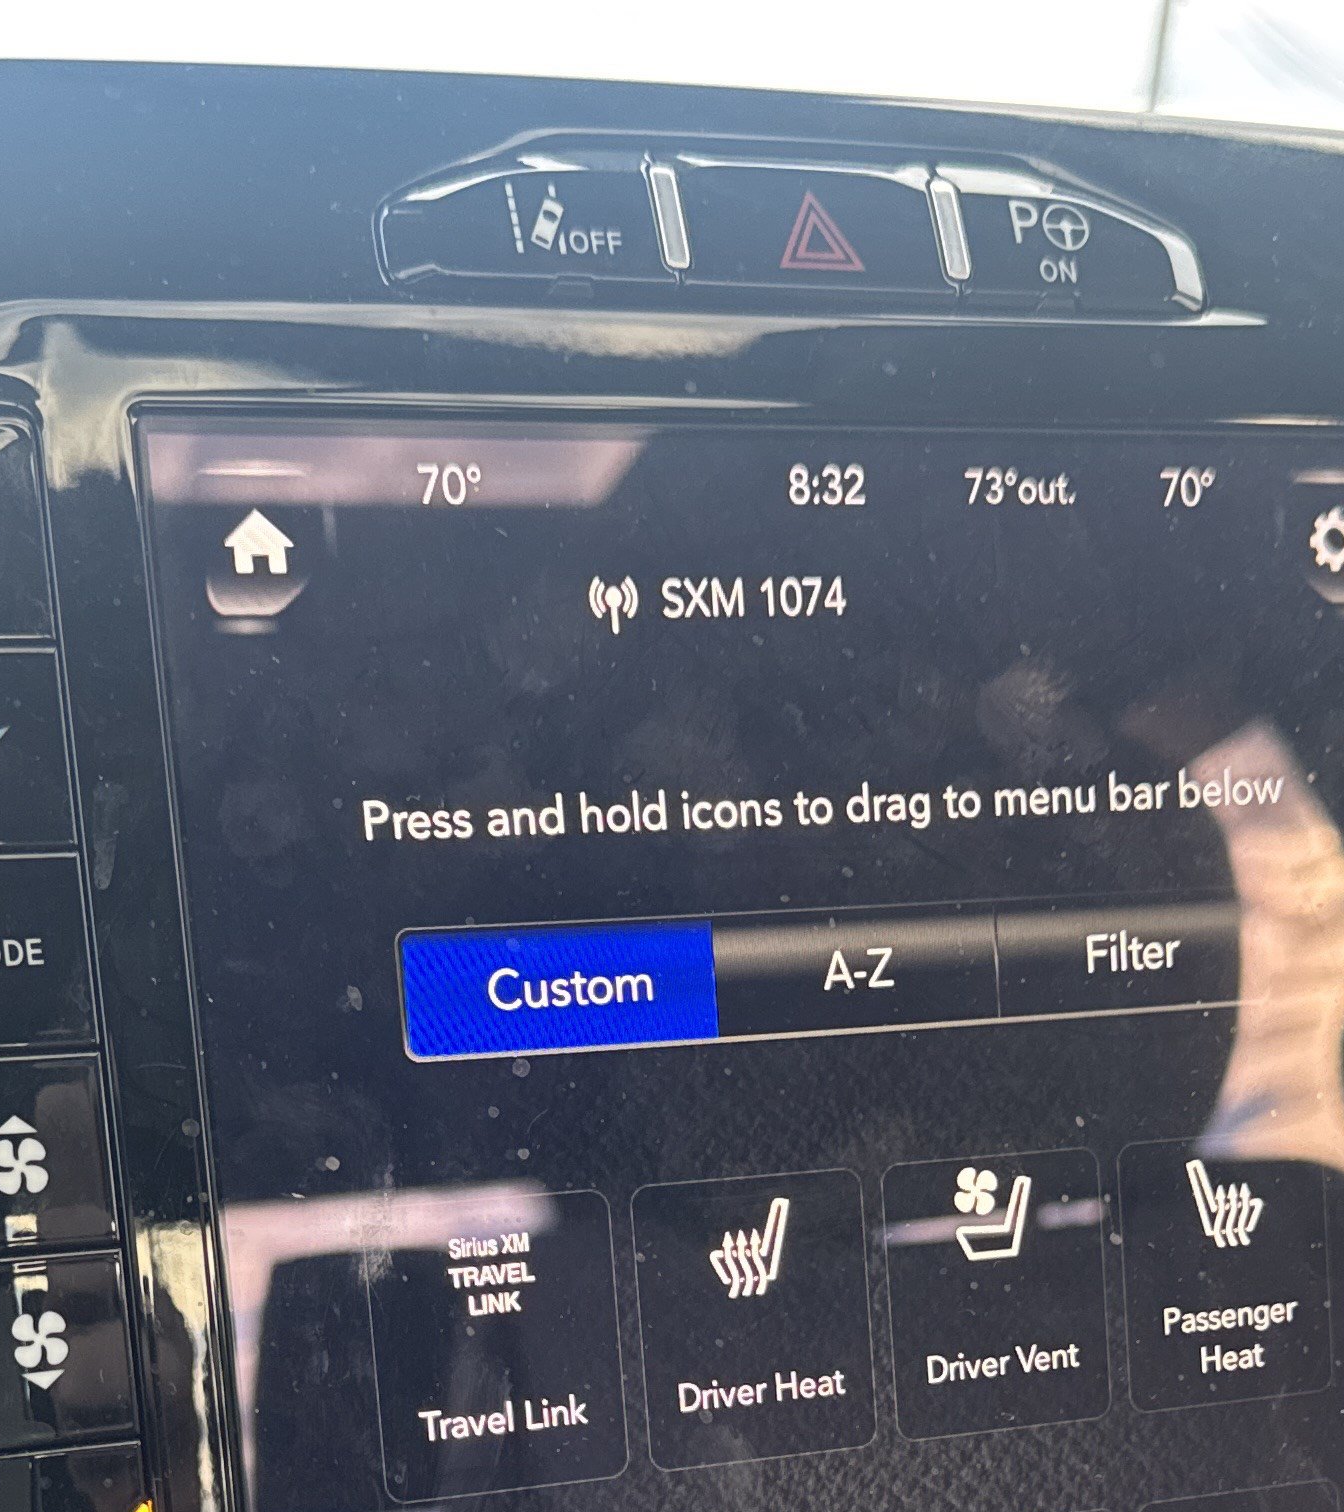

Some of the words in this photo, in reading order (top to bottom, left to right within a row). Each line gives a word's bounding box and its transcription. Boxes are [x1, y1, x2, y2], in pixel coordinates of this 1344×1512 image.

[569, 229, 622, 255] OFF
[1040, 258, 1079, 285] ON
[416, 462, 482, 506] 70°
[788, 463, 866, 506] 8:32
[1159, 466, 1216, 507] 70°
[661, 575, 745, 619] SXM
[759, 575, 846, 617] 1074
[362, 797, 472, 840] Press
[486, 792, 564, 837] and
[580, 788, 667, 833] hold
[683, 784, 783, 830] icons
[793, 790, 834, 826] to
[846, 781, 931, 829] drag
[943, 784, 982, 821] to
[994, 780, 1096, 818] menu
[1109, 771, 1167, 812] bar
[1178, 768, 1284, 809] below
[823, 946, 896, 991] A-Z
[1084, 931, 1180, 975] Filter
[486, 966, 655, 1012] Custom
[448, 1235, 498, 1260] Sirius
[501, 1232, 530, 1254] XM
[448, 1262, 536, 1288] TRAVEL
[468, 1290, 522, 1316] LINK
[1163, 1300, 1298, 1336] Passenger
[926, 1353, 1010, 1385] Driver
[1015, 1341, 1080, 1373] Vent
[1200, 1342, 1266, 1374] Heat
[677, 1379, 767, 1414] Driver
[775, 1369, 846, 1401] Heat
[418, 1400, 514, 1442] Travel
[525, 1393, 589, 1431] Link
